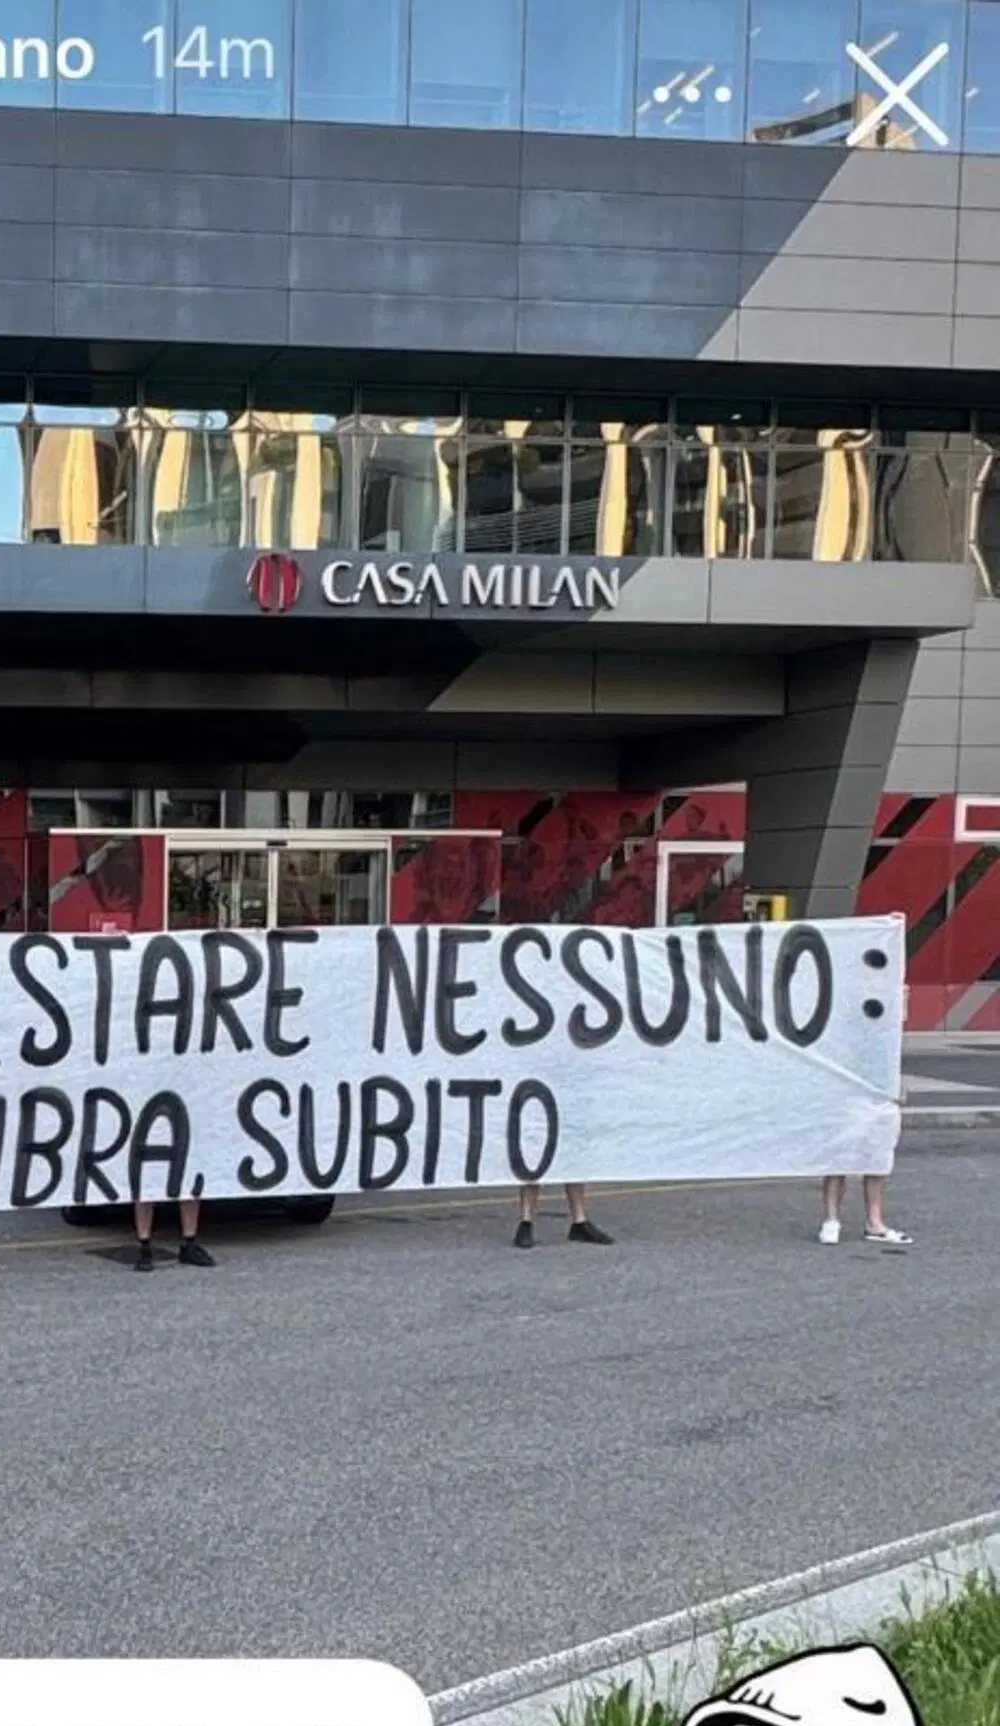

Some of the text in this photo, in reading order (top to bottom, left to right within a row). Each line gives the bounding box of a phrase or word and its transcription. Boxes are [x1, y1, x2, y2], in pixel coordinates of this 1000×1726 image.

[321, 560, 621, 611] CASA MILAN
[236, 1075, 558, 1190] SUBITO
